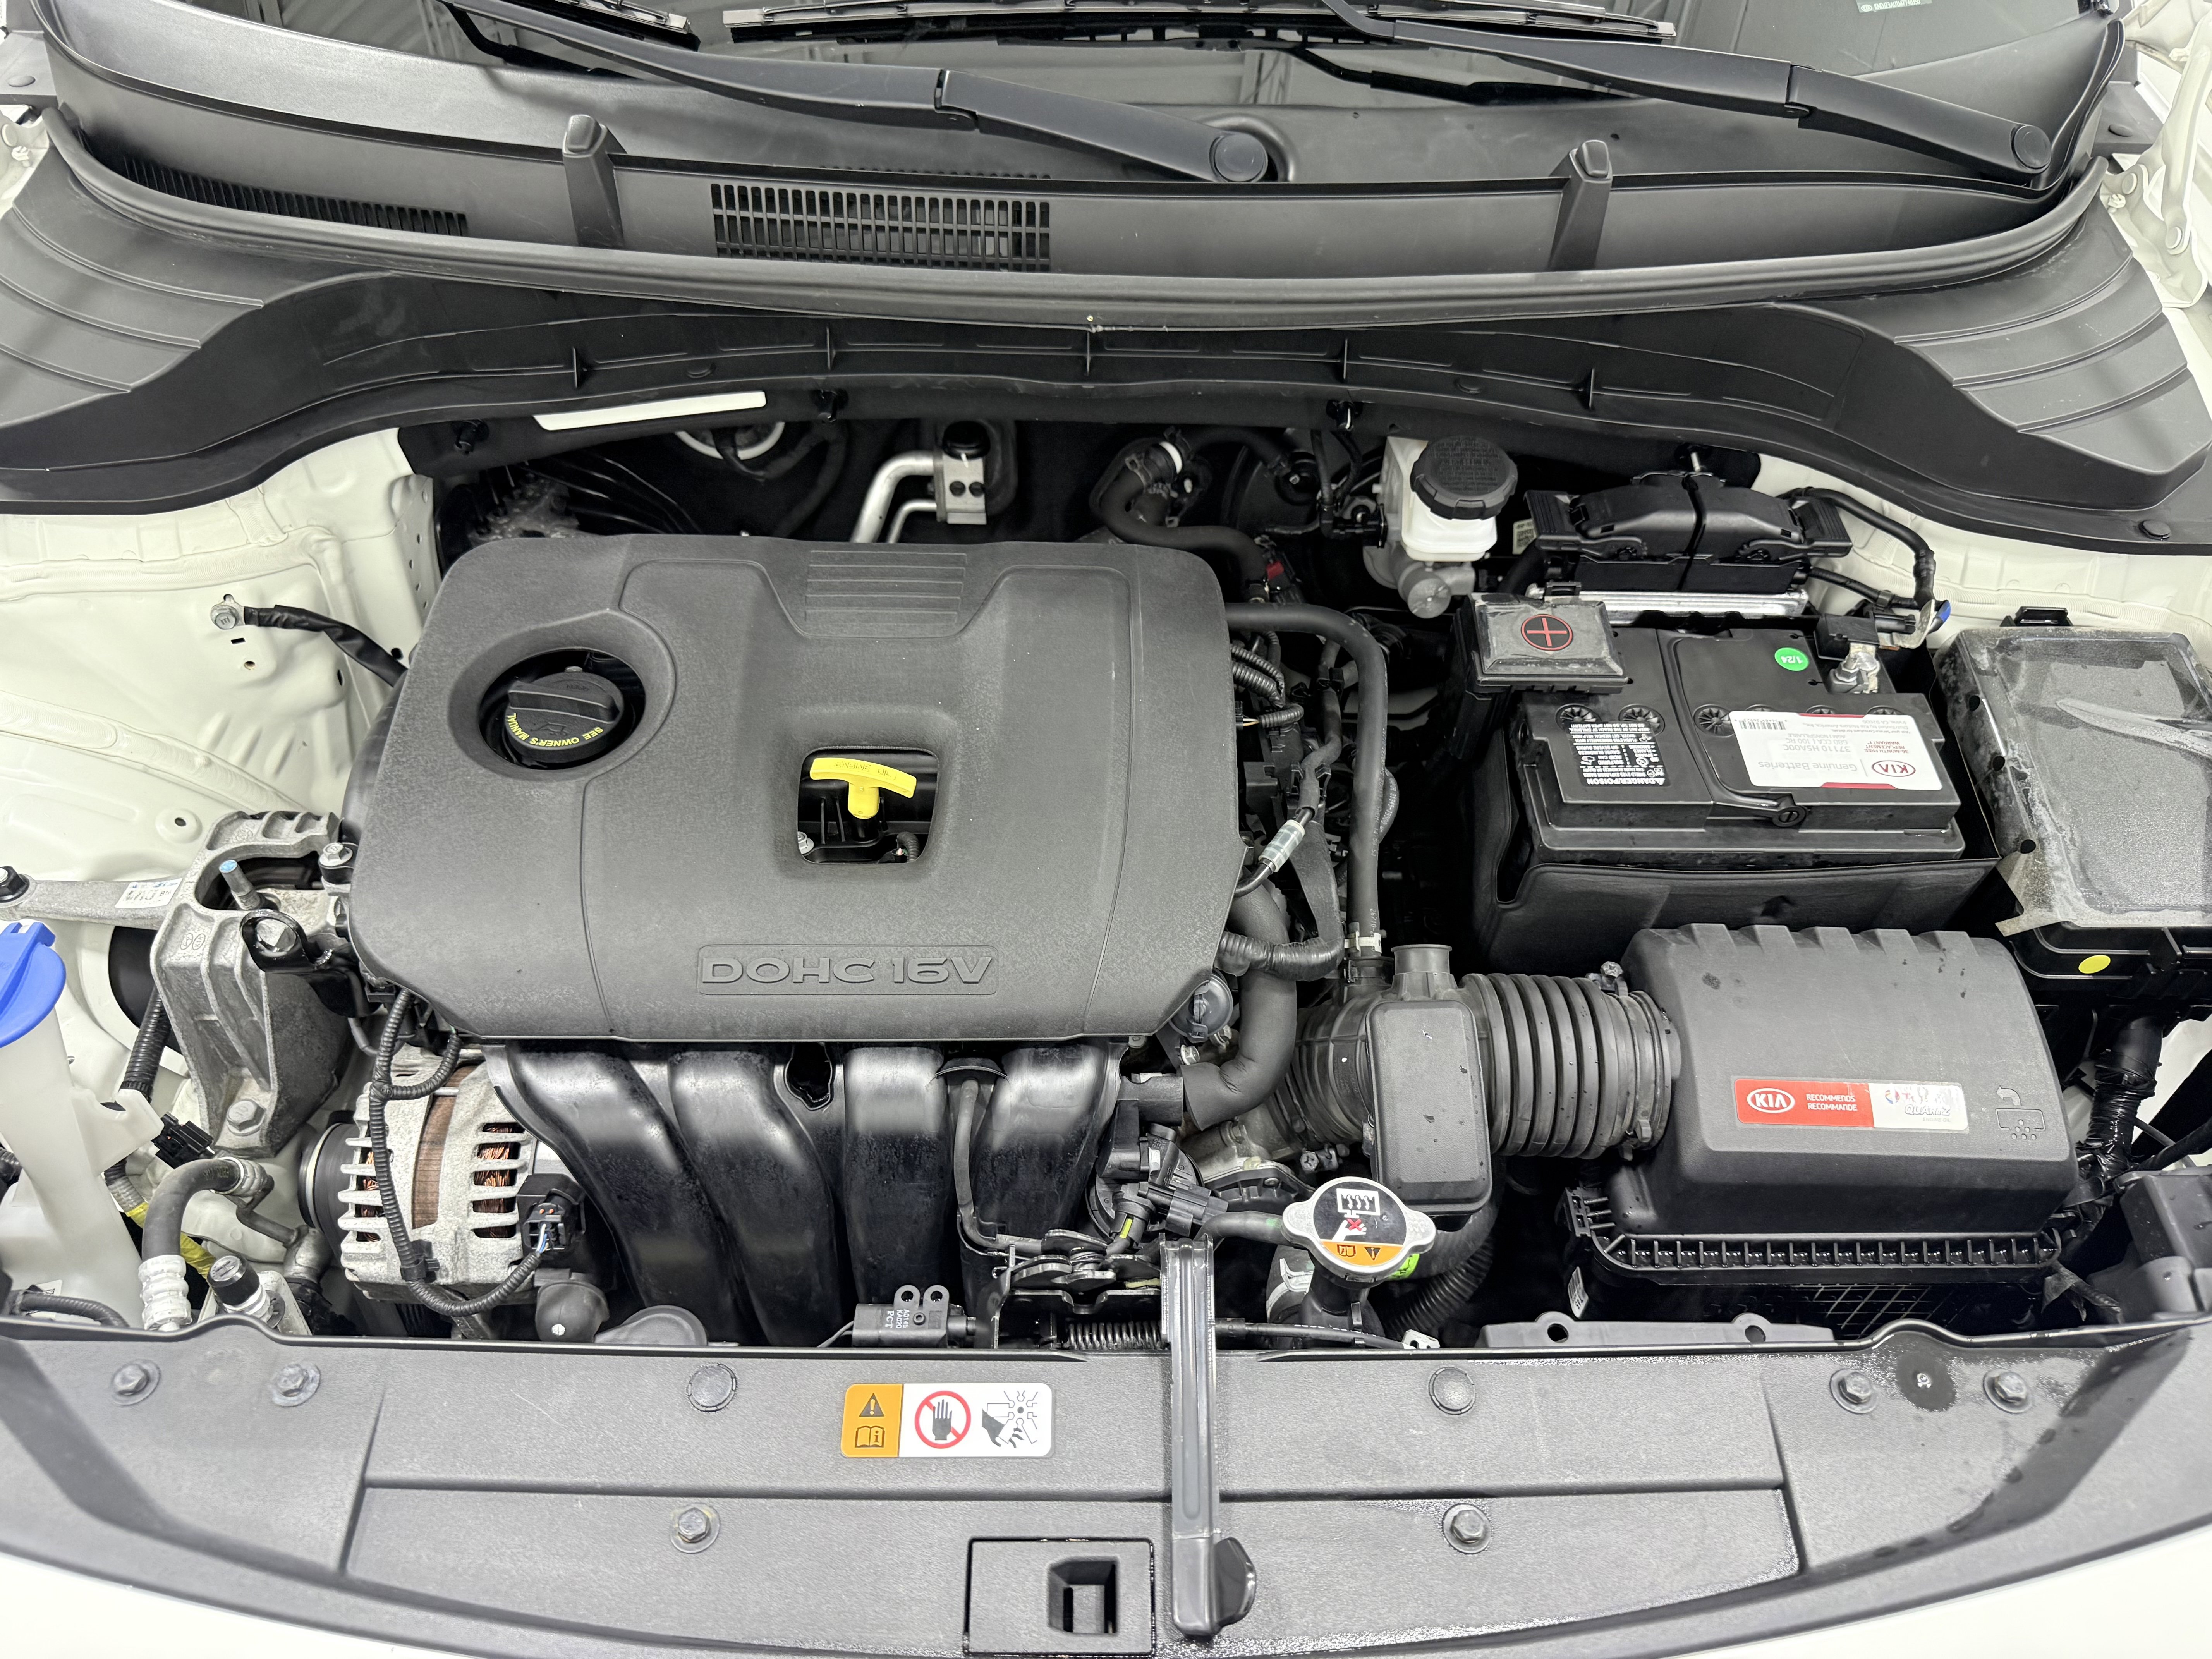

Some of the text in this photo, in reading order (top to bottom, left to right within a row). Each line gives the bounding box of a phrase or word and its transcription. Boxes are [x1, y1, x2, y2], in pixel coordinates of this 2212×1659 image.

[1781, 656, 1803, 664] 1/24
[507, 713, 603, 747] SEE OWNER'S MANUAL
[835, 762, 891, 777] ENGINE OIL
[1758, 762, 1857, 772] Genuine Batteries
[1878, 764, 1908, 773] KIA
[702, 957, 993, 984] DOHC 16V
[1755, 1093, 1856, 1108] KIA RECOMMENDS
[1807, 1103, 1858, 1111] RECOMMANDE
[1905, 1104, 1950, 1115] QUARTZ
[884, 1310, 895, 1329] PCT
